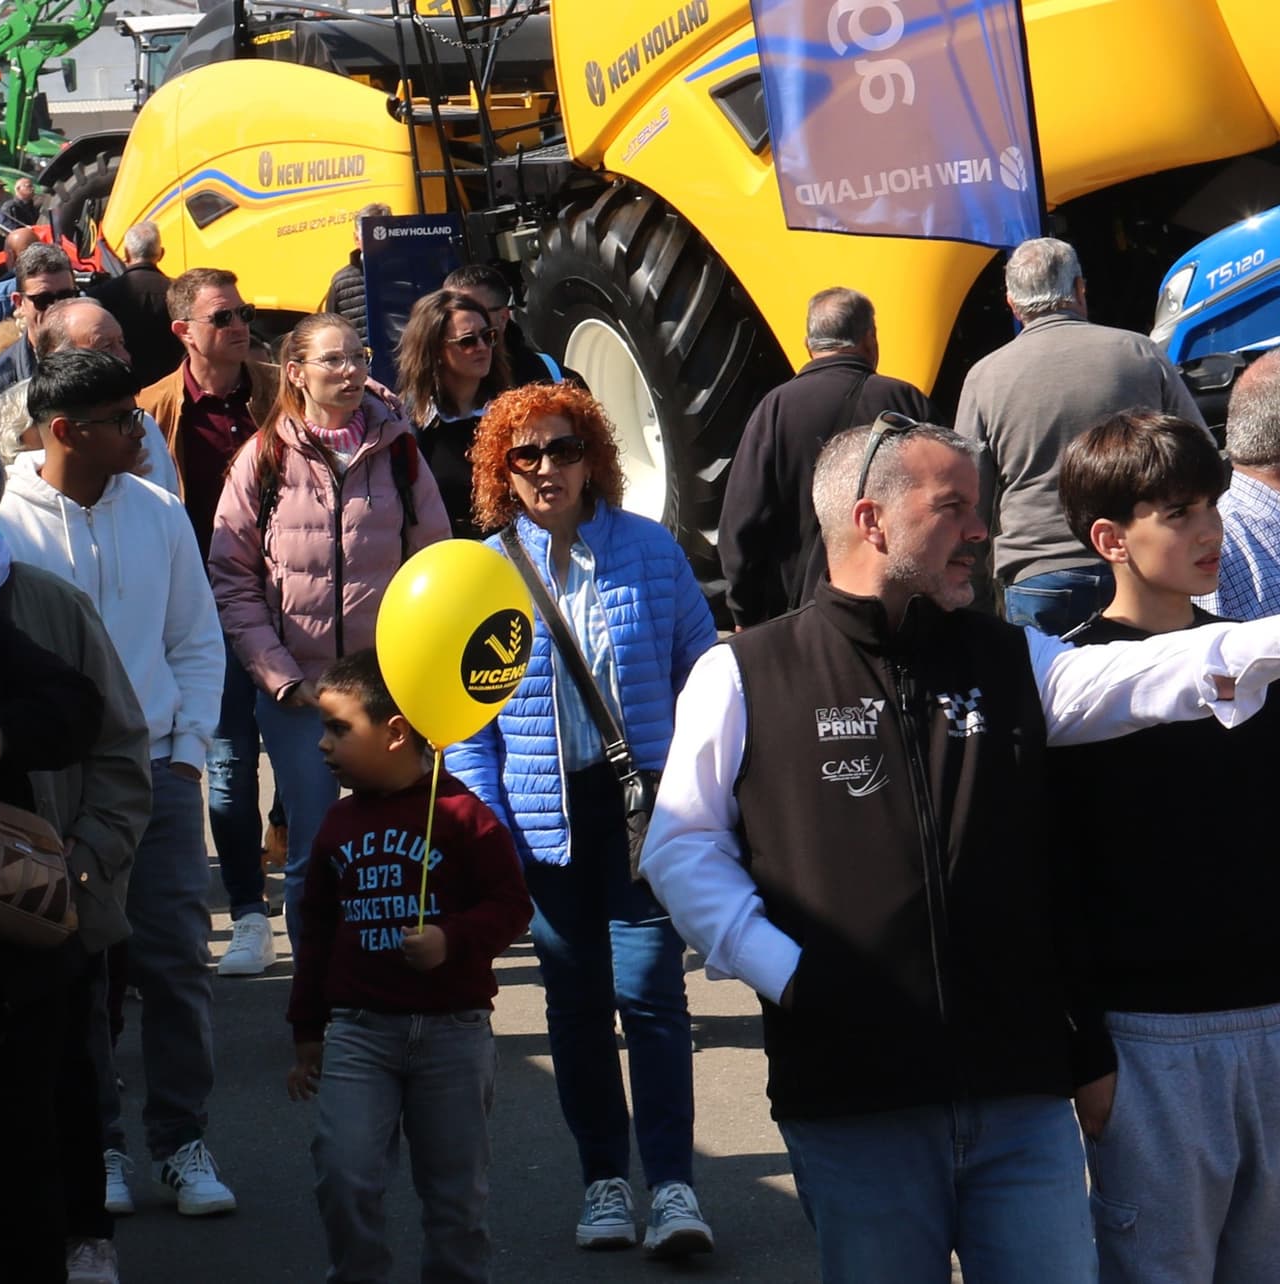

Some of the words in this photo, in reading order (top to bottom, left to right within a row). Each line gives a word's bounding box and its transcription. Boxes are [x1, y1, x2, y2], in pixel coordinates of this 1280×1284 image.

[607, 43, 641, 94] NEW
[641, 0, 709, 64] HOLLAND
[277, 162, 305, 187] NEW
[307, 154, 365, 181] HOLLAND
[388, 227, 409, 237] NEW
[409, 226, 452, 236] HOLLAND
[1206, 249, 1265, 290] T5.120
[815, 706, 867, 721] EASY
[817, 720, 878, 737] PRINT
[821, 755, 872, 775] CASÉ
[383, 828, 443, 871] CLUB
[357, 863, 403, 891] 1973
